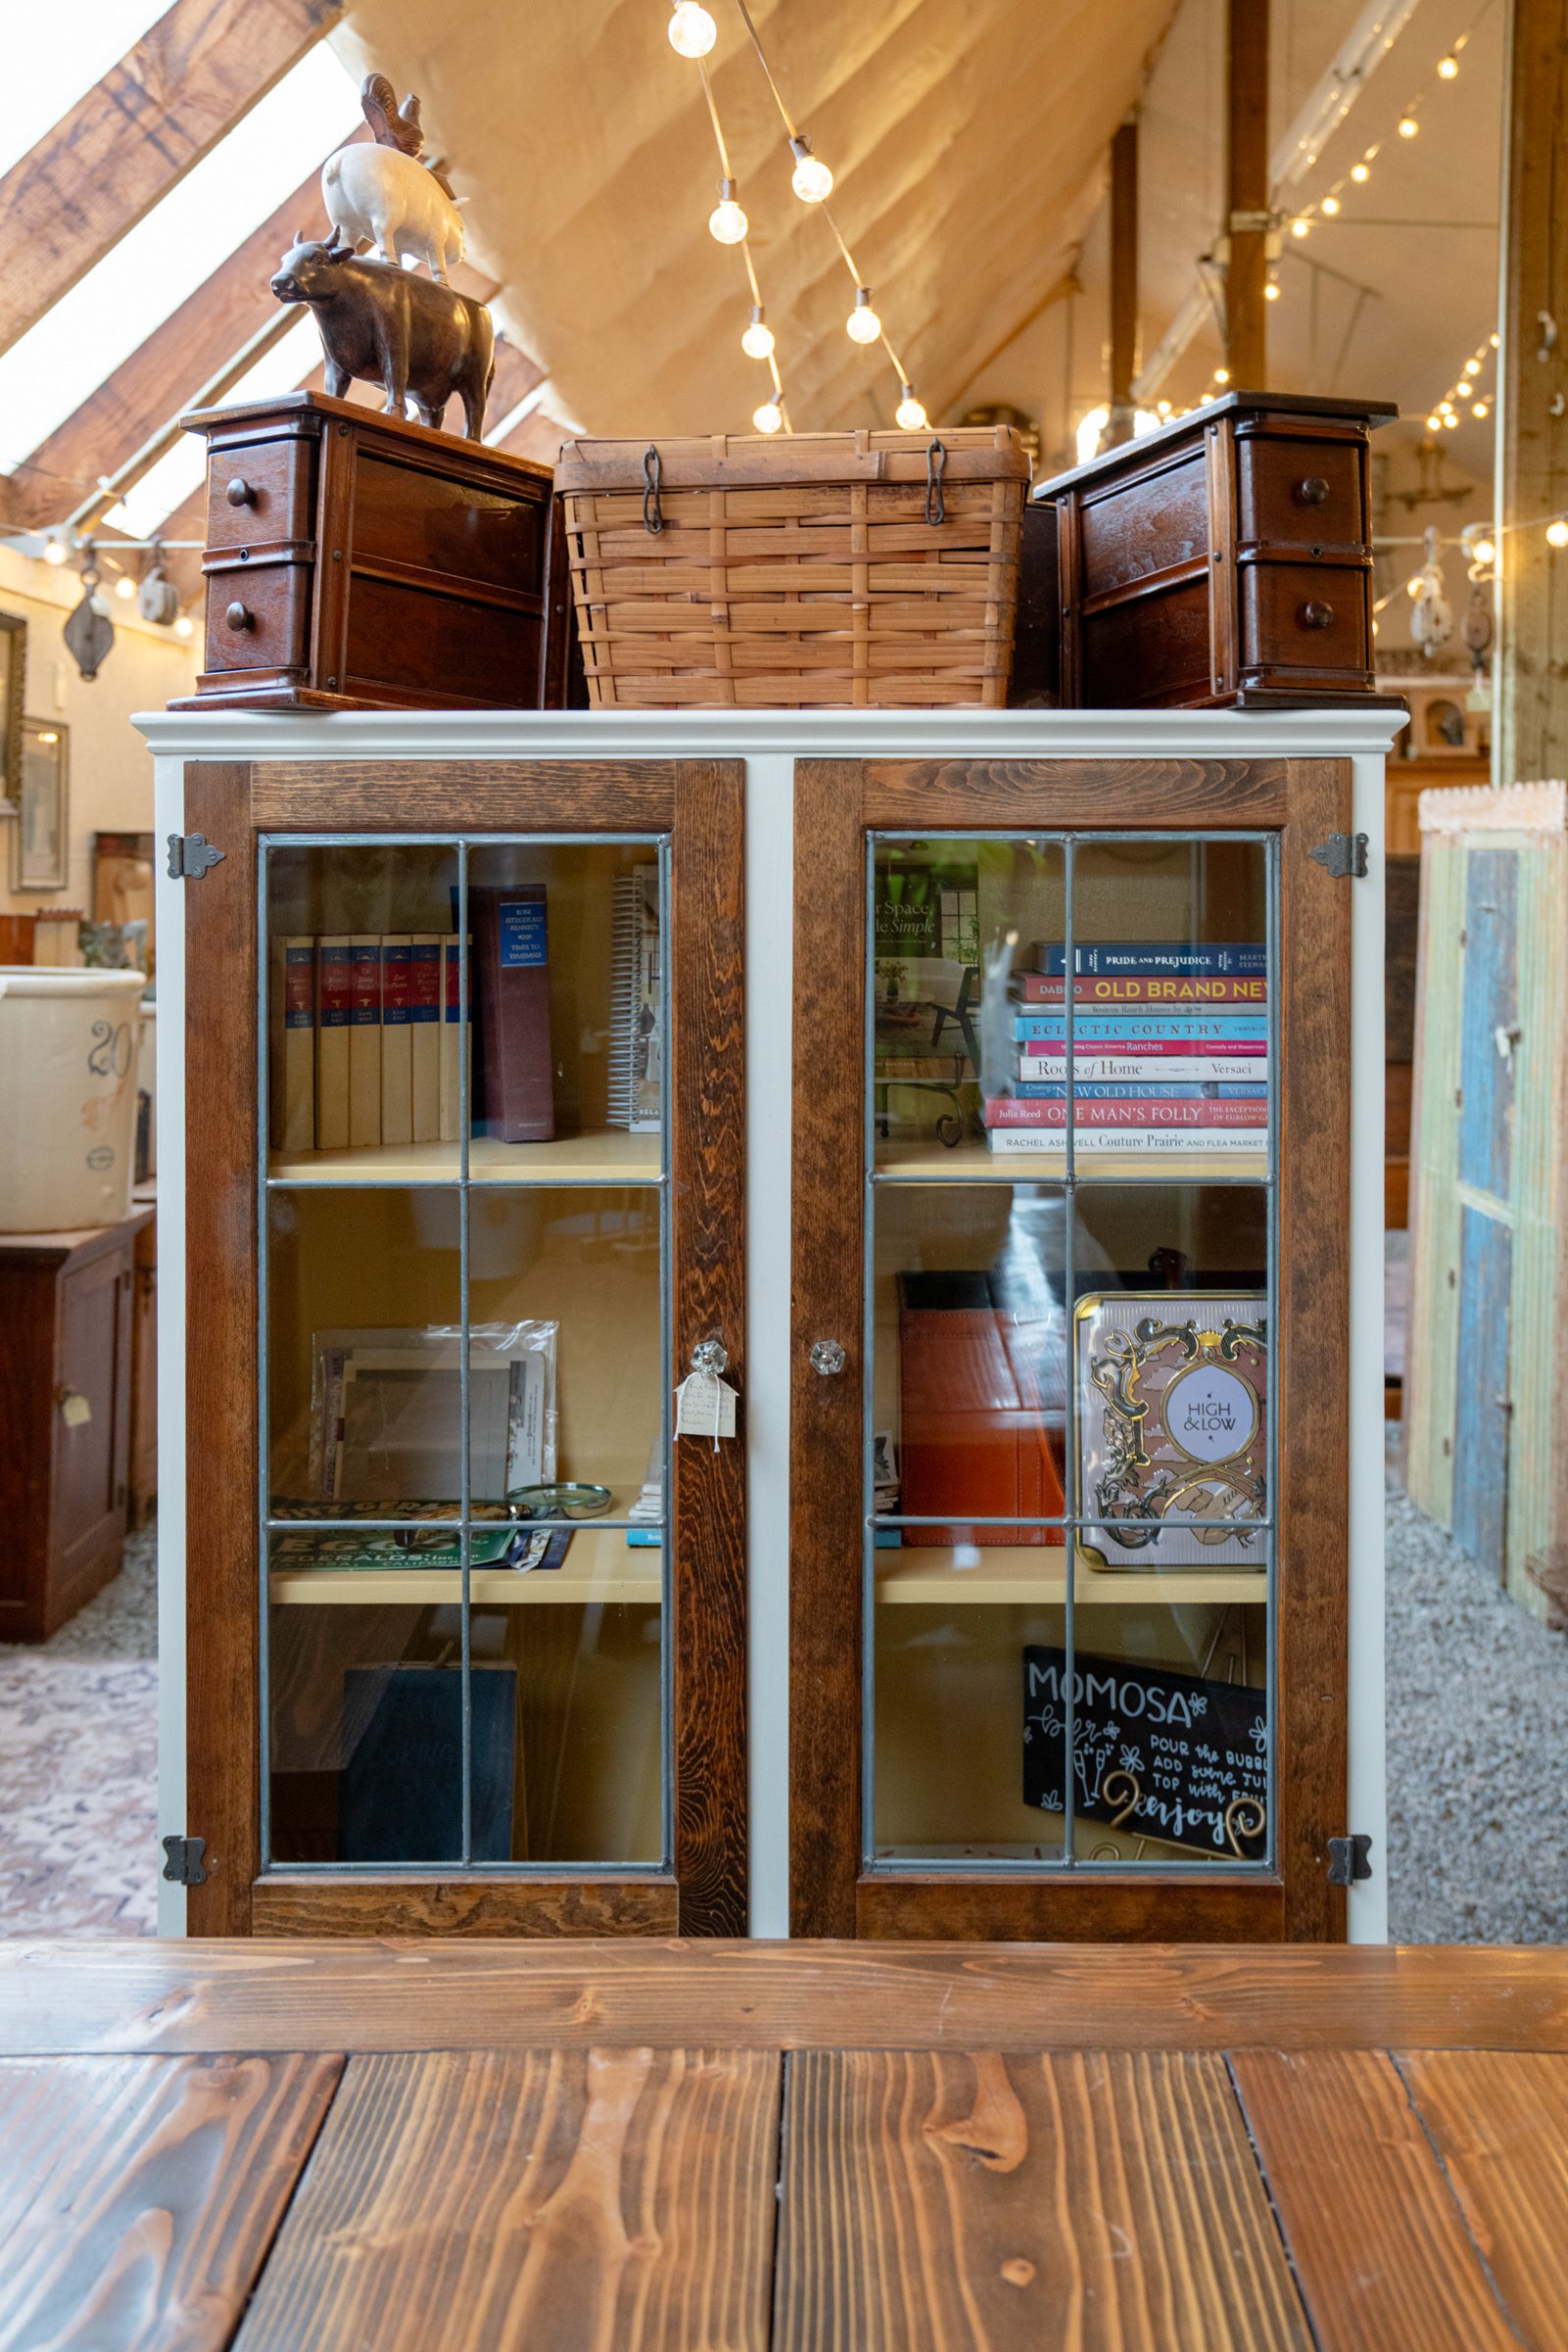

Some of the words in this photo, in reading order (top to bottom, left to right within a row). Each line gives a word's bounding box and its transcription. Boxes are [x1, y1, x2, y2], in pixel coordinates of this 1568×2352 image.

[891, 918, 935, 936] Simple
[1105, 956, 1137, 965] PRIDE
[1154, 956, 1212, 968] PREJUDICE
[1040, 985, 1082, 995] DABO
[1095, 981, 1141, 998] OLD
[1148, 981, 1227, 998] BRAND
[1234, 981, 1267, 998] NE
[1032, 1025, 1122, 1035] ECLCTIC
[1131, 1025, 1223, 1035] COUNTRY
[88, 1019, 132, 1078] 20
[1127, 1042, 1163, 1052] Ranches
[1038, 1060, 1080, 1075] Roos
[1084, 1061, 1098, 1079] of
[1101, 1060, 1143, 1075] Home
[1211, 1062, 1252, 1075] Versaci
[1094, 1085, 1126, 1098] OLD
[1129, 1085, 1178, 1098] HOUSE
[999, 1109, 1018, 1118] Julia
[1020, 1109, 1041, 1118] Reed
[1091, 1106, 1145, 1121] MAN'S
[1152, 1106, 1202, 1121] FOLLY
[1099, 1134, 1144, 1148] Couture
[1147, 1134, 1184, 1148] Prairie
[1188, 1402, 1231, 1416] HIGH
[1028, 1661, 1193, 1730] MOMOSA
[1151, 1734, 1190, 1756] POUR
[1195, 1743, 1220, 1764] the
[1153, 1755, 1183, 1772] ADD
[1191, 1764, 1237, 1787] some
[1152, 1772, 1180, 1791] TOP
[1189, 1781, 1225, 1804] with
[1134, 1794, 1226, 1845] enjoy
